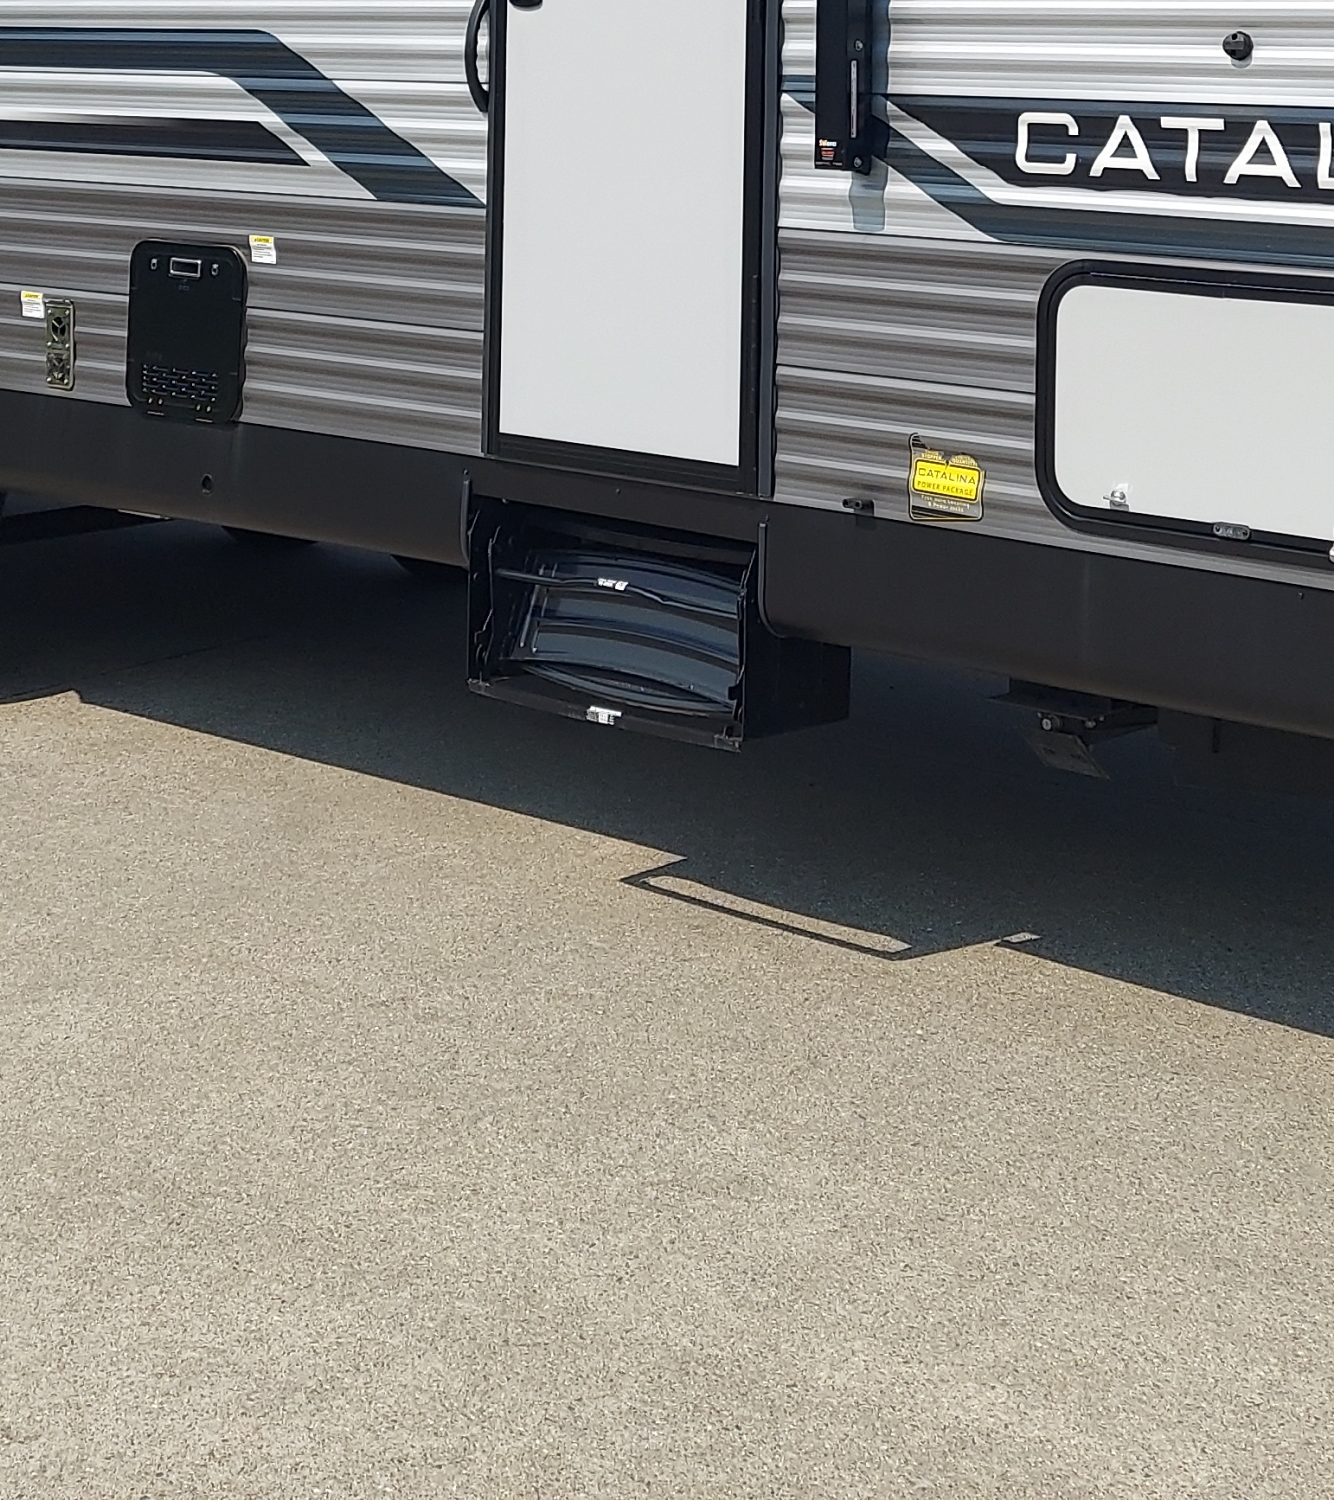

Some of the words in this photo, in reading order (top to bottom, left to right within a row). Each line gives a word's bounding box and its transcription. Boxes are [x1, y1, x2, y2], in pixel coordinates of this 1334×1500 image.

[918, 467, 976, 485] CATALINA
[917, 480, 940, 490] POWER
[942, 485, 974, 497] PACKAGE
